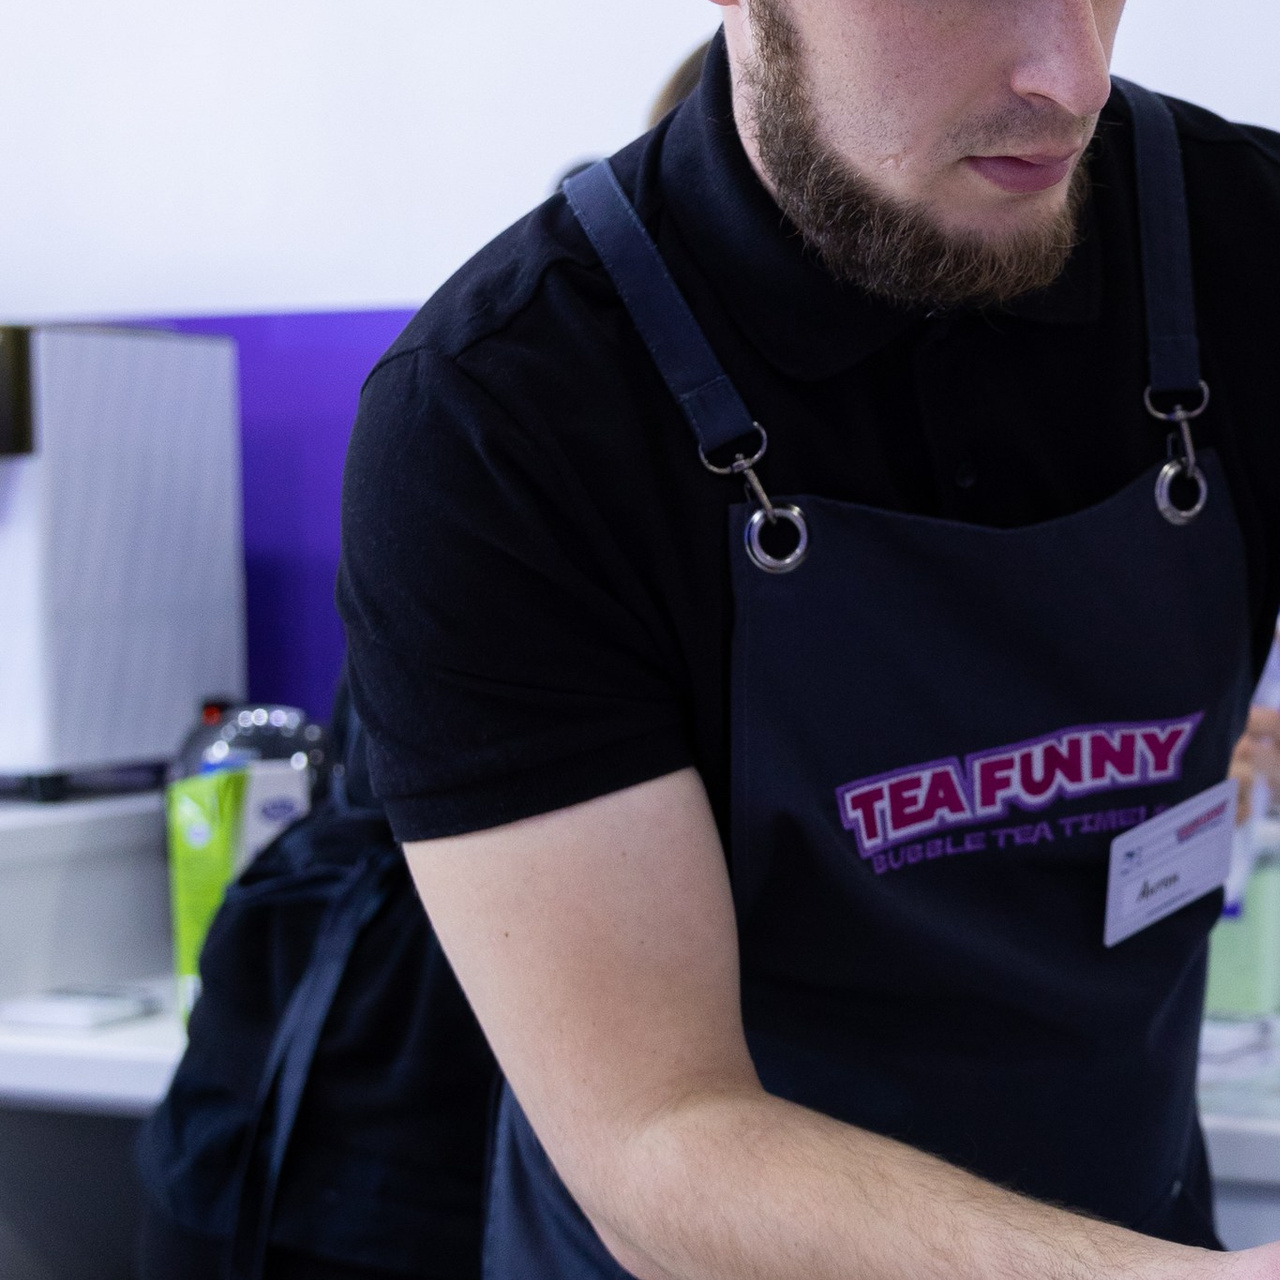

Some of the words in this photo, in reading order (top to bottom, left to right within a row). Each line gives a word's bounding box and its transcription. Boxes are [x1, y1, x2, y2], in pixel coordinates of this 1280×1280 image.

[844, 763, 970, 850] TEA
[972, 719, 1196, 819] FUNNY
[871, 832, 987, 875] BUBBLE
[987, 821, 1053, 850] TEA
